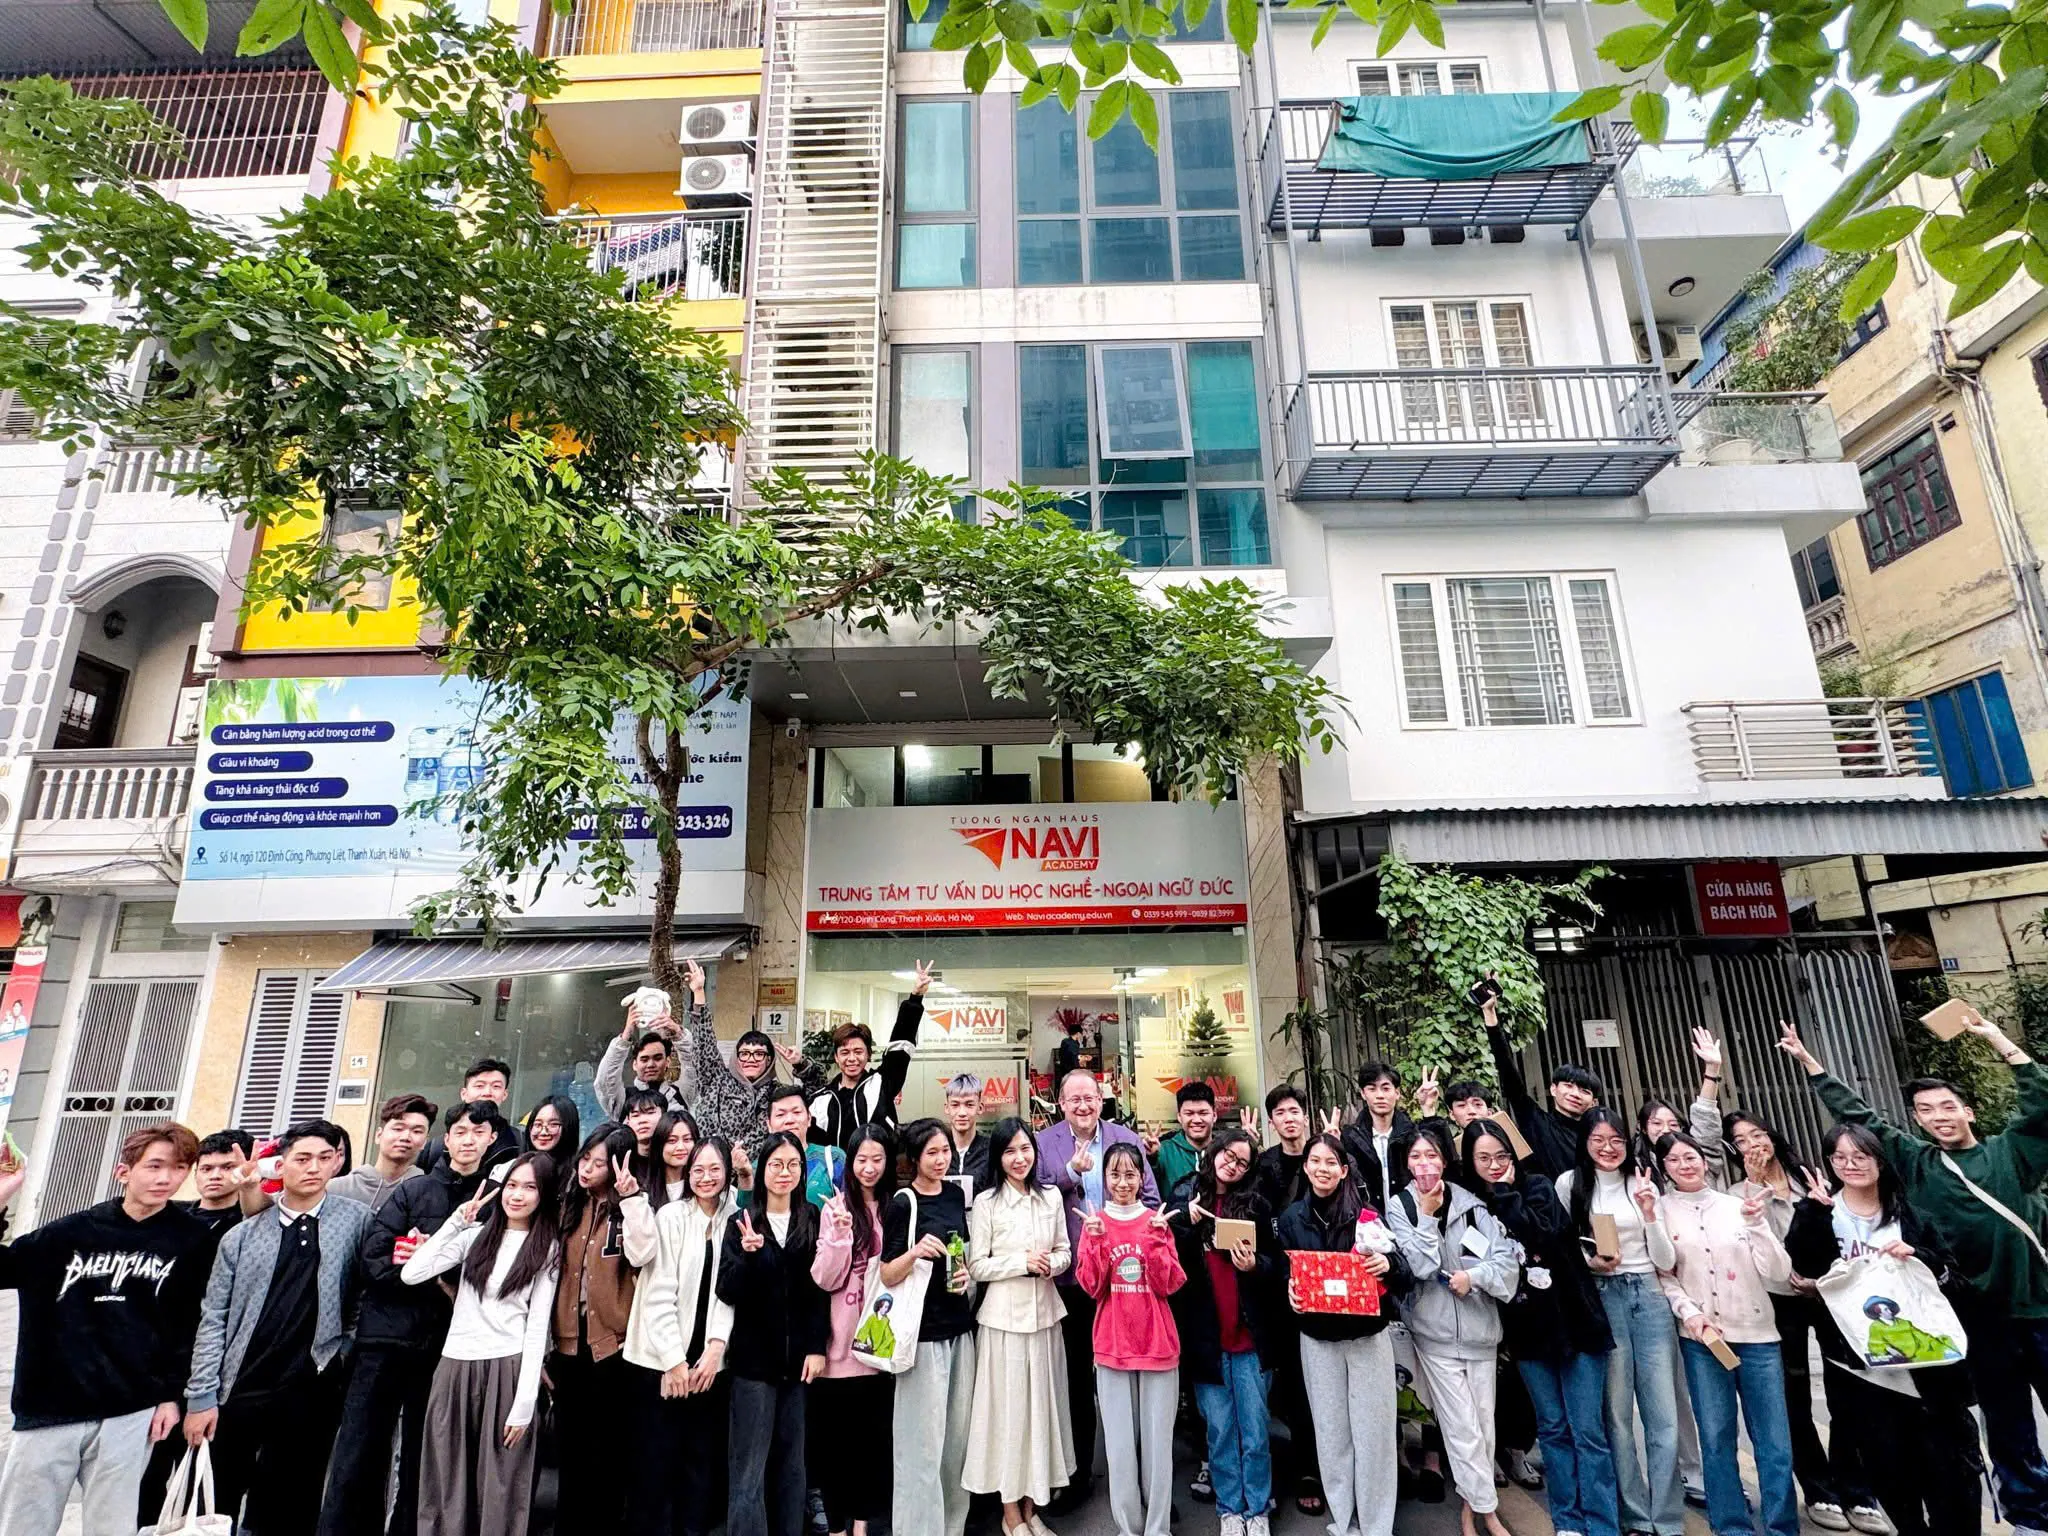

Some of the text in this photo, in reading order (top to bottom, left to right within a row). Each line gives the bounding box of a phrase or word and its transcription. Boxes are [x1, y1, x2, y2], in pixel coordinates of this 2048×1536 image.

[240, 728, 260, 741] bằng
[262, 728, 281, 739] hàm
[283, 727, 306, 741] lượng
[308, 728, 325, 738] acid
[326, 728, 348, 739] trong
[350, 728, 361, 737] cơ
[362, 724, 376, 736] thể
[219, 756, 279, 768] Giàu vi khoáng
[215, 784, 235, 797] Tăng
[236, 784, 252, 794] khả
[253, 785, 274, 796] năng
[293, 782, 308, 795] độc
[310, 781, 319, 793] tố
[210, 812, 230, 825] Giúp
[282, 811, 304, 824] động
[305, 810, 315, 820] và
[340, 809, 362, 822] mạnh
[364, 810, 381, 819] hơn
[951, 814, 1099, 825] TUONG NGAN HAUS
[1011, 826, 1099, 859] NAVI
[255, 851, 267, 862] 120
[1044, 860, 1096, 870] ACADEMY
[819, 887, 872, 902] TRUNG
[879, 884, 909, 901] TÂM
[917, 884, 939, 900] TƯ
[945, 880, 975, 900] VẤN
[982, 885, 1003, 900] DU
[1010, 883, 1043, 902] HỌC
[1160, 877, 1193, 896] NGỮ
[1200, 876, 1233, 896] ĐỨC
[1706, 879, 1773, 897] CỬA HÀNG
[899, 914, 923, 923] Thanh
[1711, 902, 1777, 920] BÁCH HÓA
[770, 1013, 782, 1026] 12
[955, 1008, 1005, 1028] NAVI
[982, 1076, 1018, 1097] AVI
